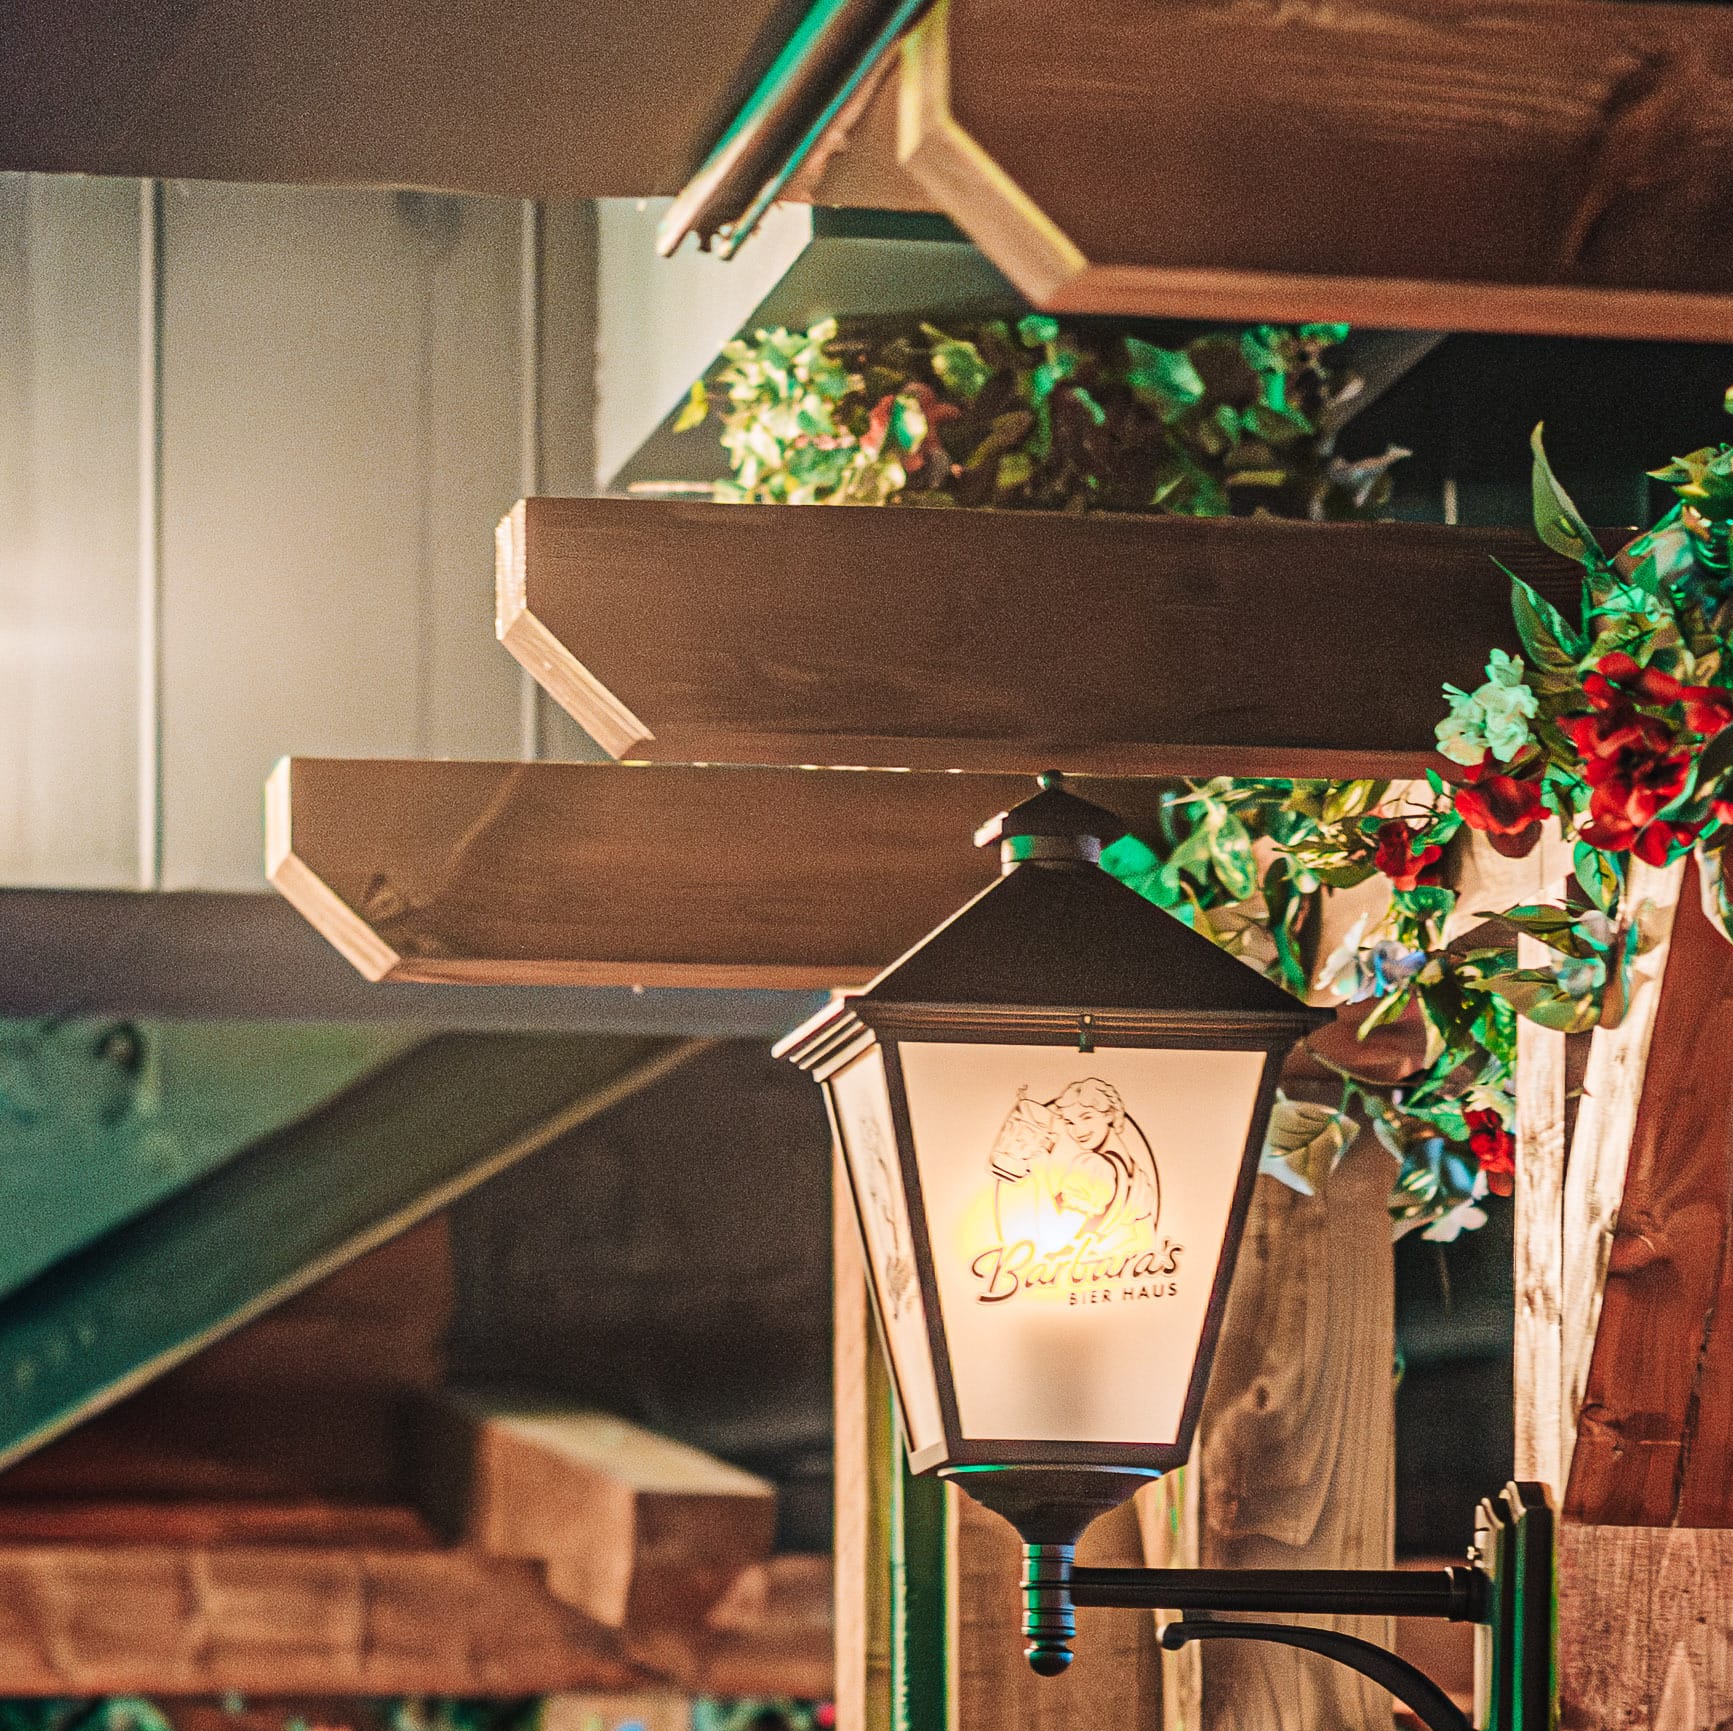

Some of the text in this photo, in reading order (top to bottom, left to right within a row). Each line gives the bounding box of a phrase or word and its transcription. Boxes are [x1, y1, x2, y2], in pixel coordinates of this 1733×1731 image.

[971, 1238, 1182, 1303] Barbara's
[1069, 1282, 1178, 1306] BIER HAUS
